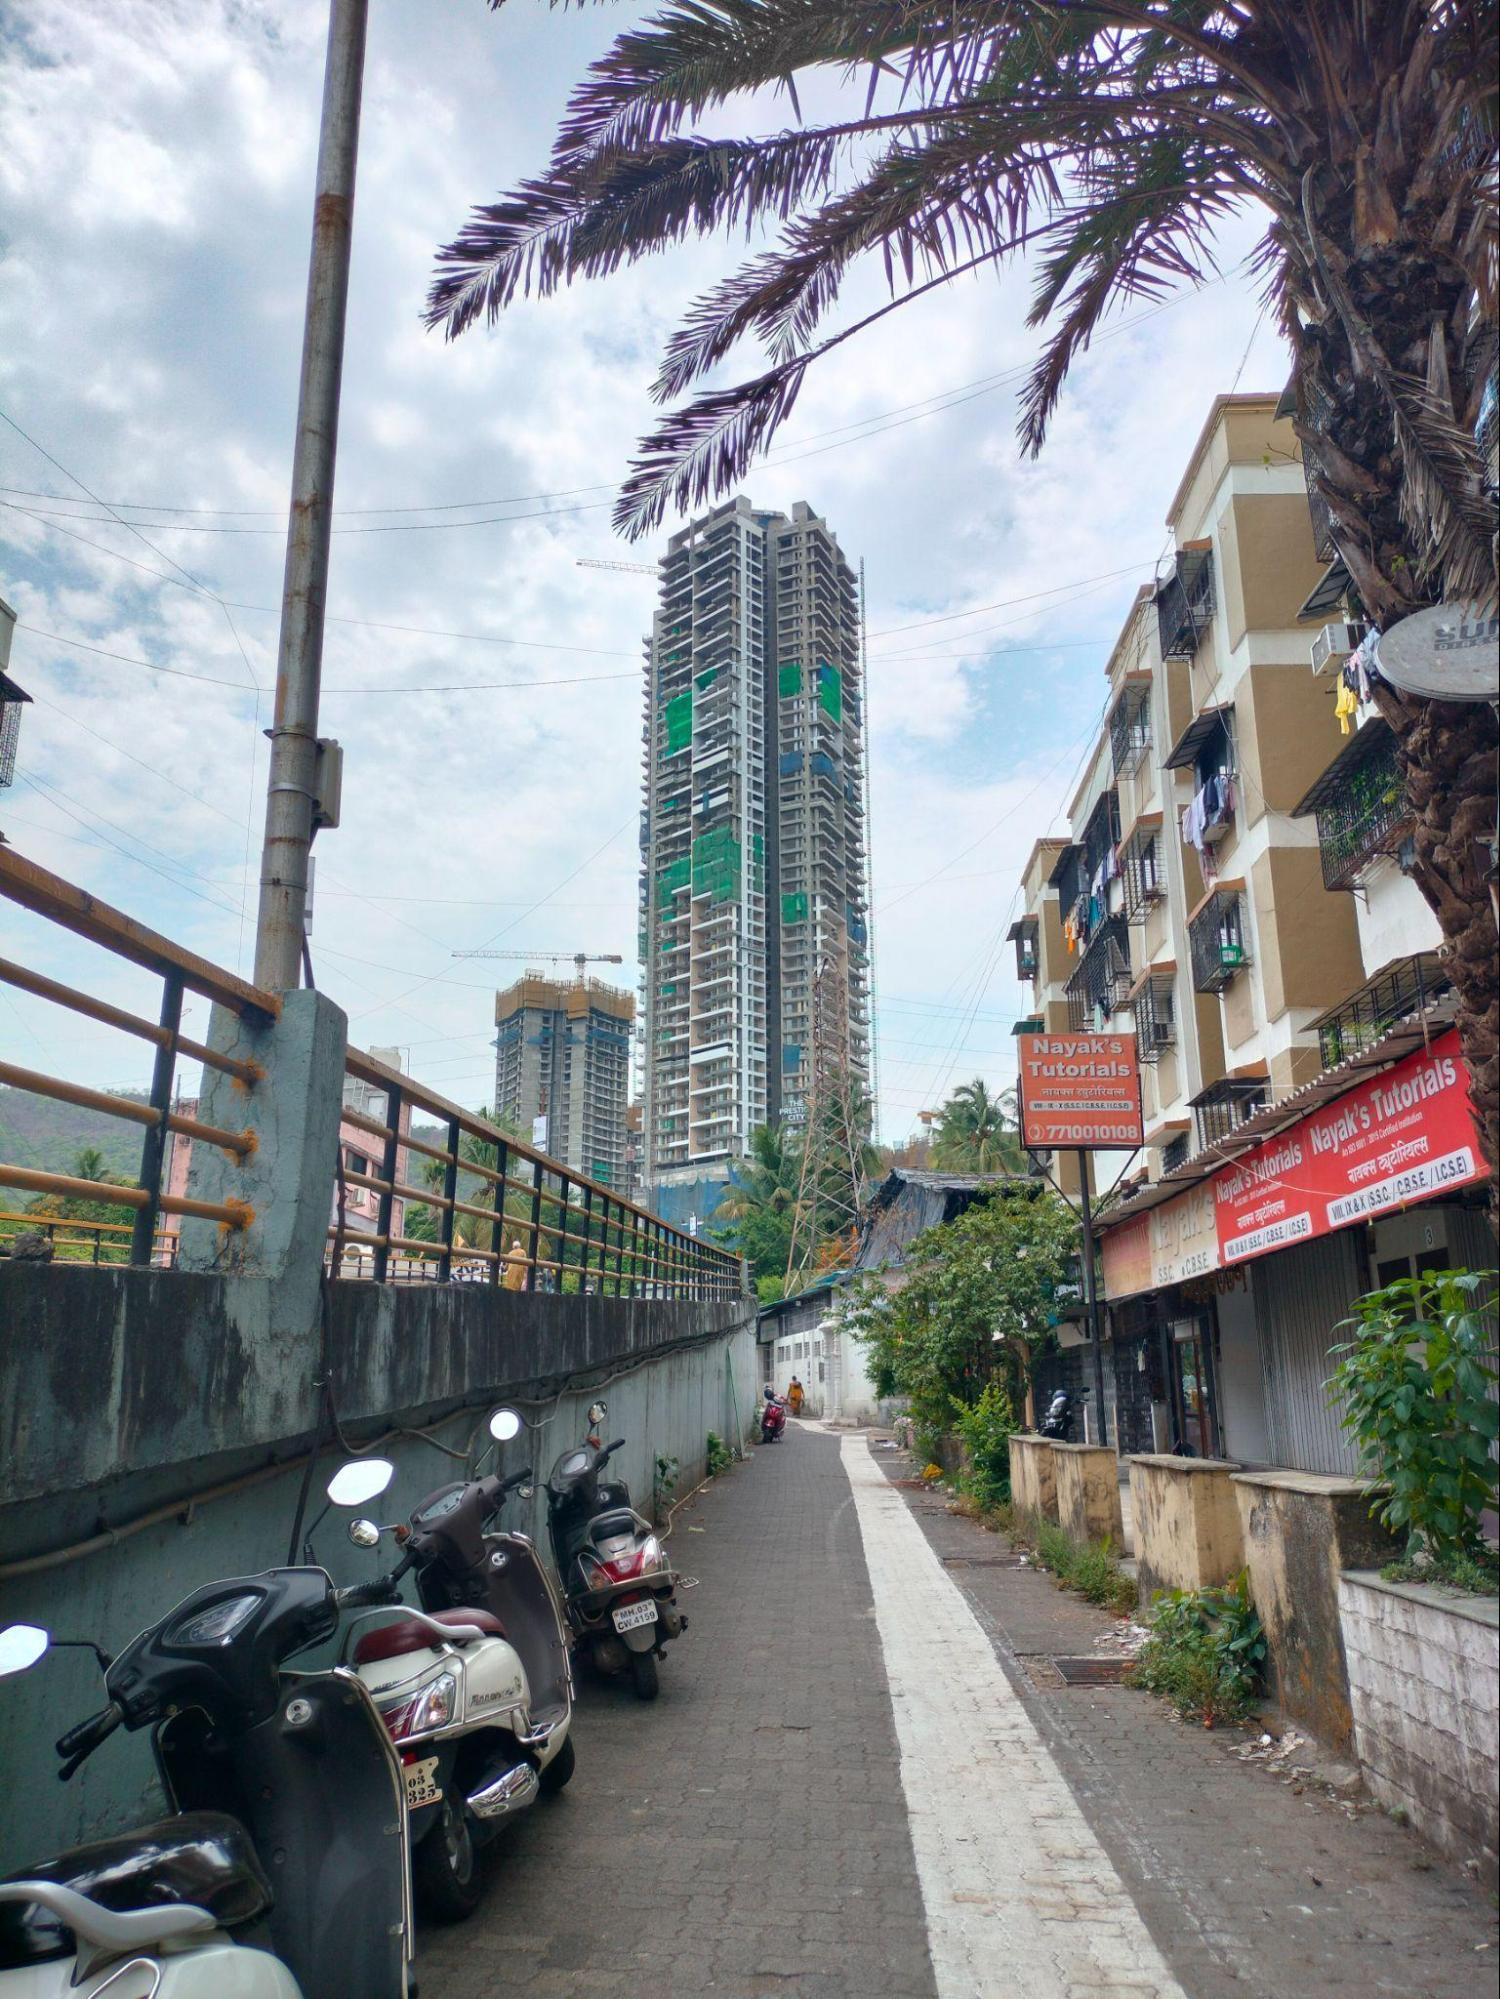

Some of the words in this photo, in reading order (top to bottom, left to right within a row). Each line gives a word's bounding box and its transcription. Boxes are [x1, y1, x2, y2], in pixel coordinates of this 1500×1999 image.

[1032, 1039, 1123, 1057] Nayak's
[1028, 1061, 1131, 1077] Tutorials
[1310, 1102, 1371, 1155] Nayak's
[1370, 1058, 1457, 1122] Tutorials
[788, 1113, 806, 1121] CITY
[1046, 1125, 1138, 1139] 7710010108
[1216, 1168, 1252, 1204] Nayak's
[1251, 1141, 1303, 1184] Tutorials
[408, 1774, 426, 1789] 03
